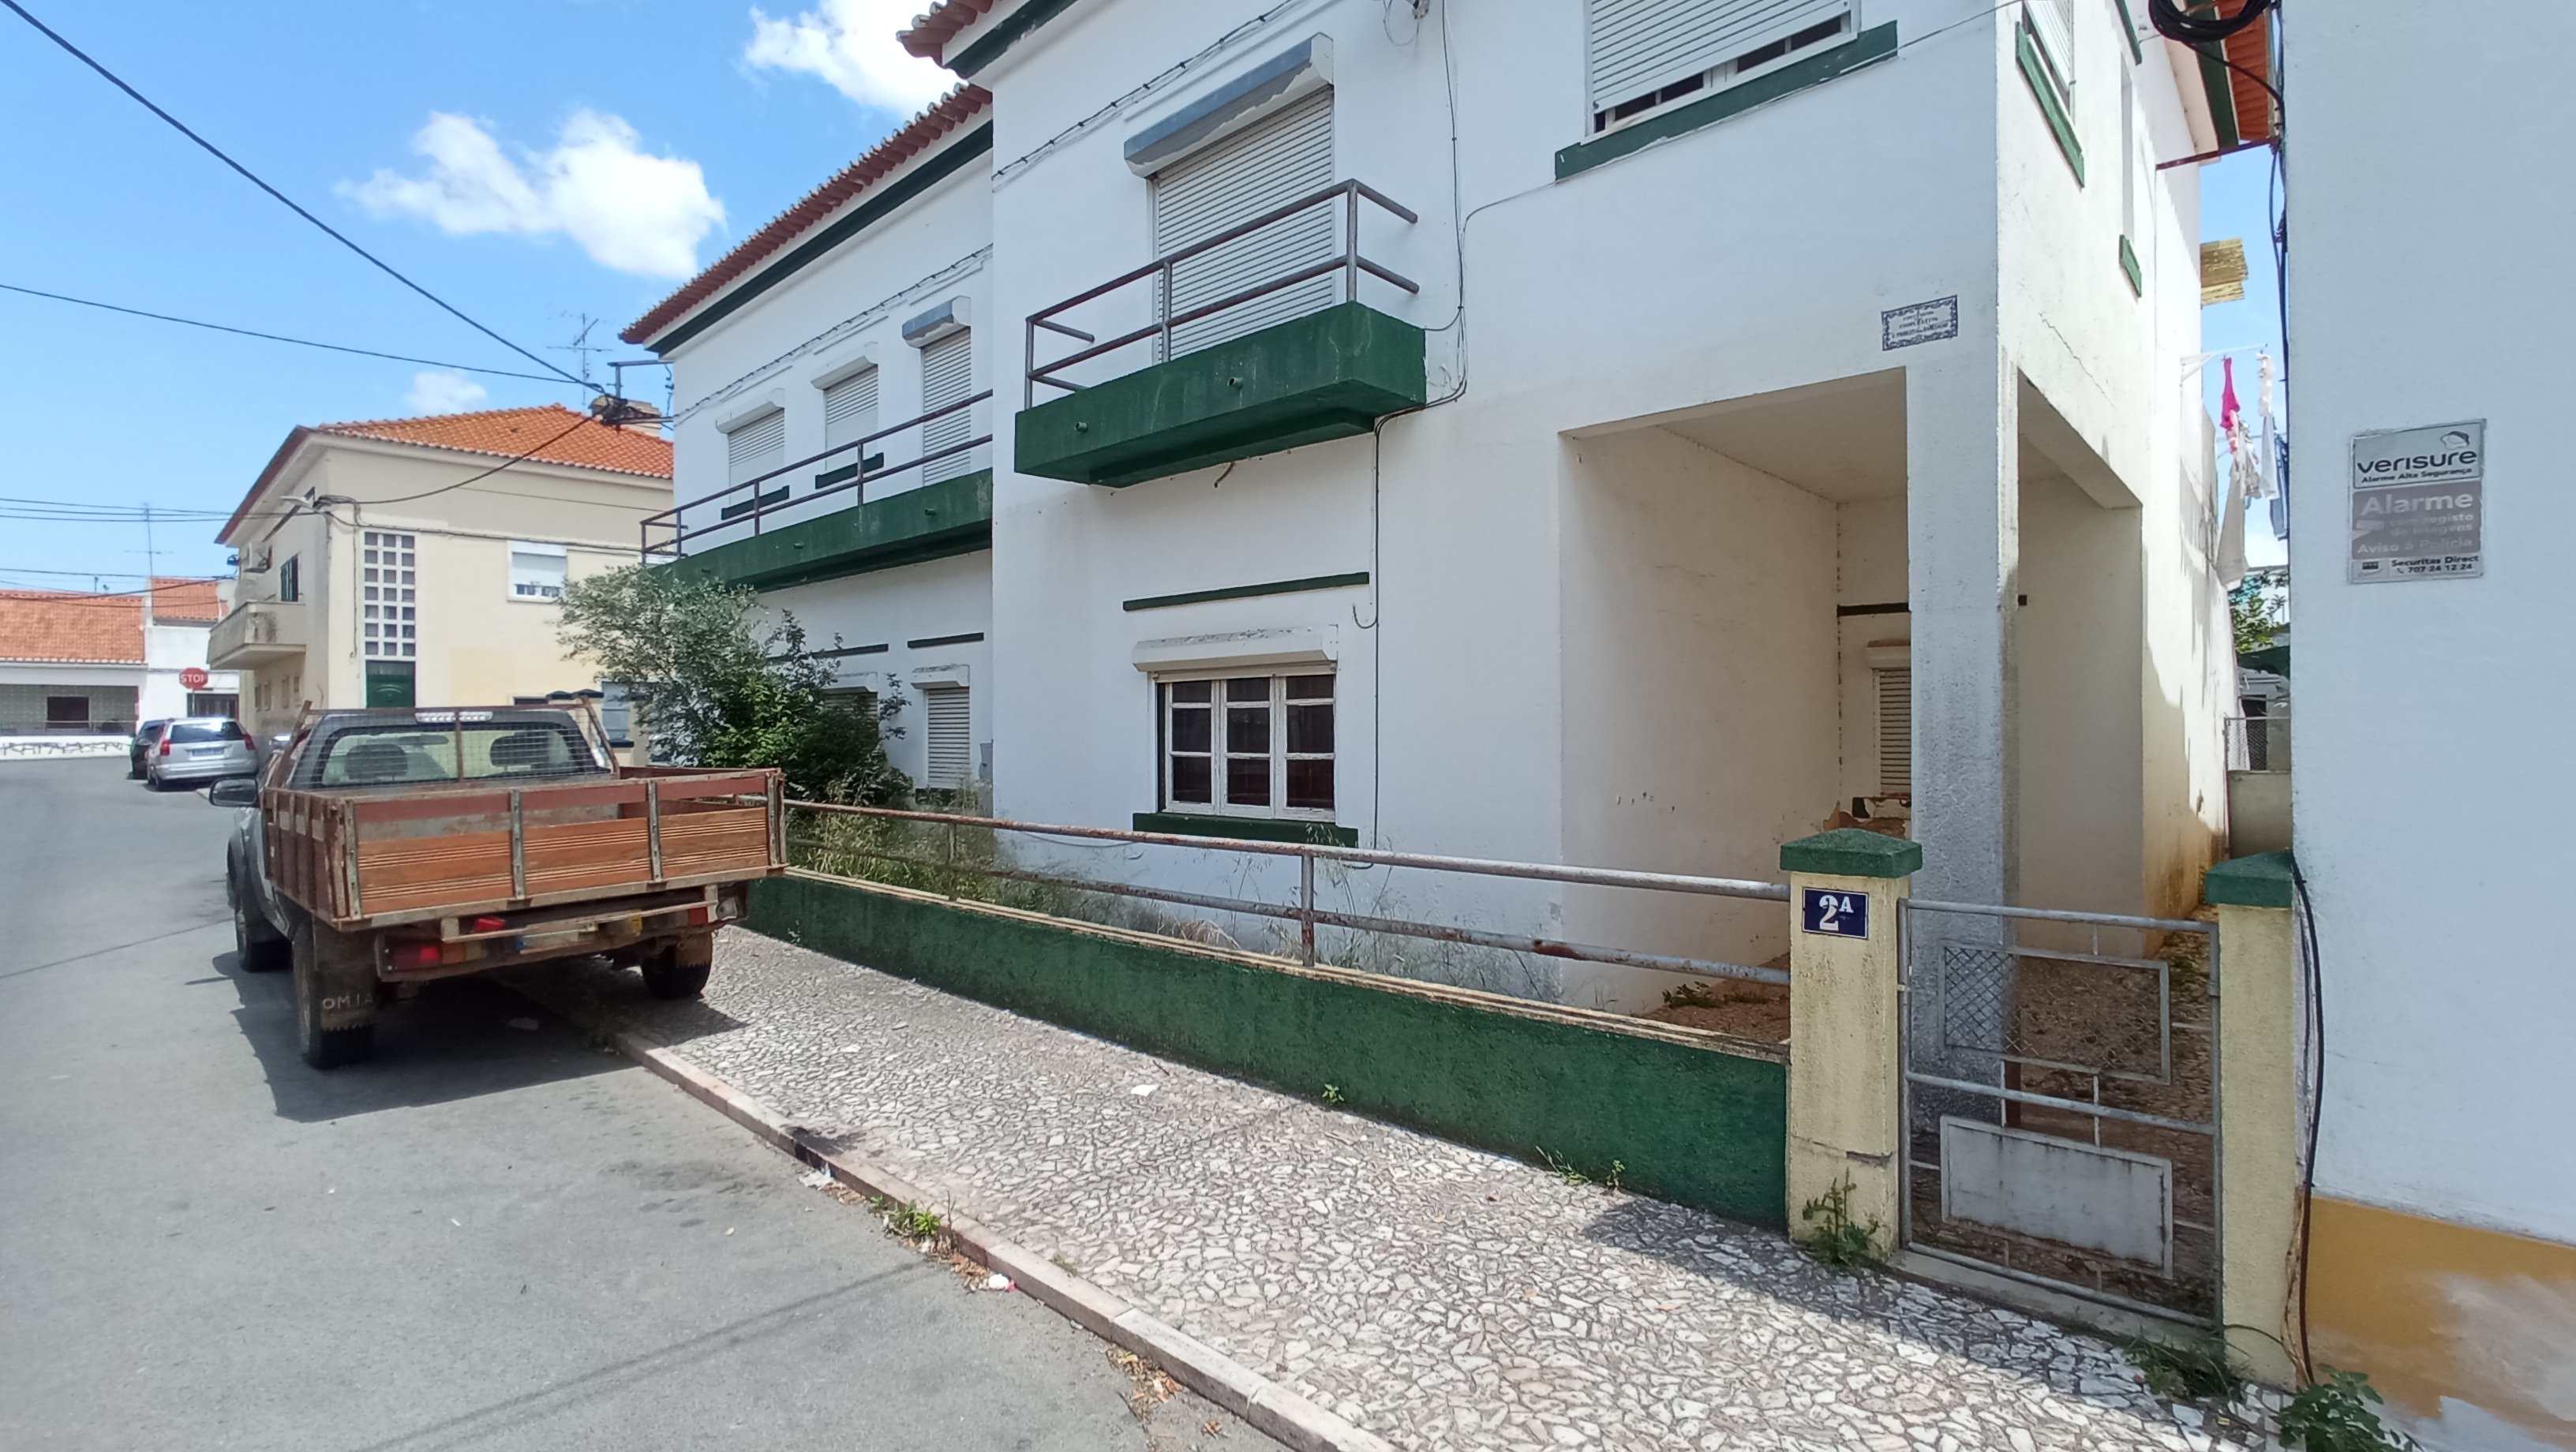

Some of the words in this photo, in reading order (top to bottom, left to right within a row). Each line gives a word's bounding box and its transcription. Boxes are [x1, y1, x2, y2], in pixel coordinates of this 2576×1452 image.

[2357, 451, 2477, 473] verisure
[2361, 475, 2394, 484] Alarme
[2421, 468, 2473, 478] Segurança
[2361, 493, 2473, 516] Alarme
[2357, 543, 2400, 554] Aviso
[2420, 537, 2473, 548] Polícia
[2391, 558, 2441, 567] Securitas
[2444, 555, 2480, 564] Direct
[181, 674, 205, 683] STOP
[1819, 895, 1854, 931] 2A
